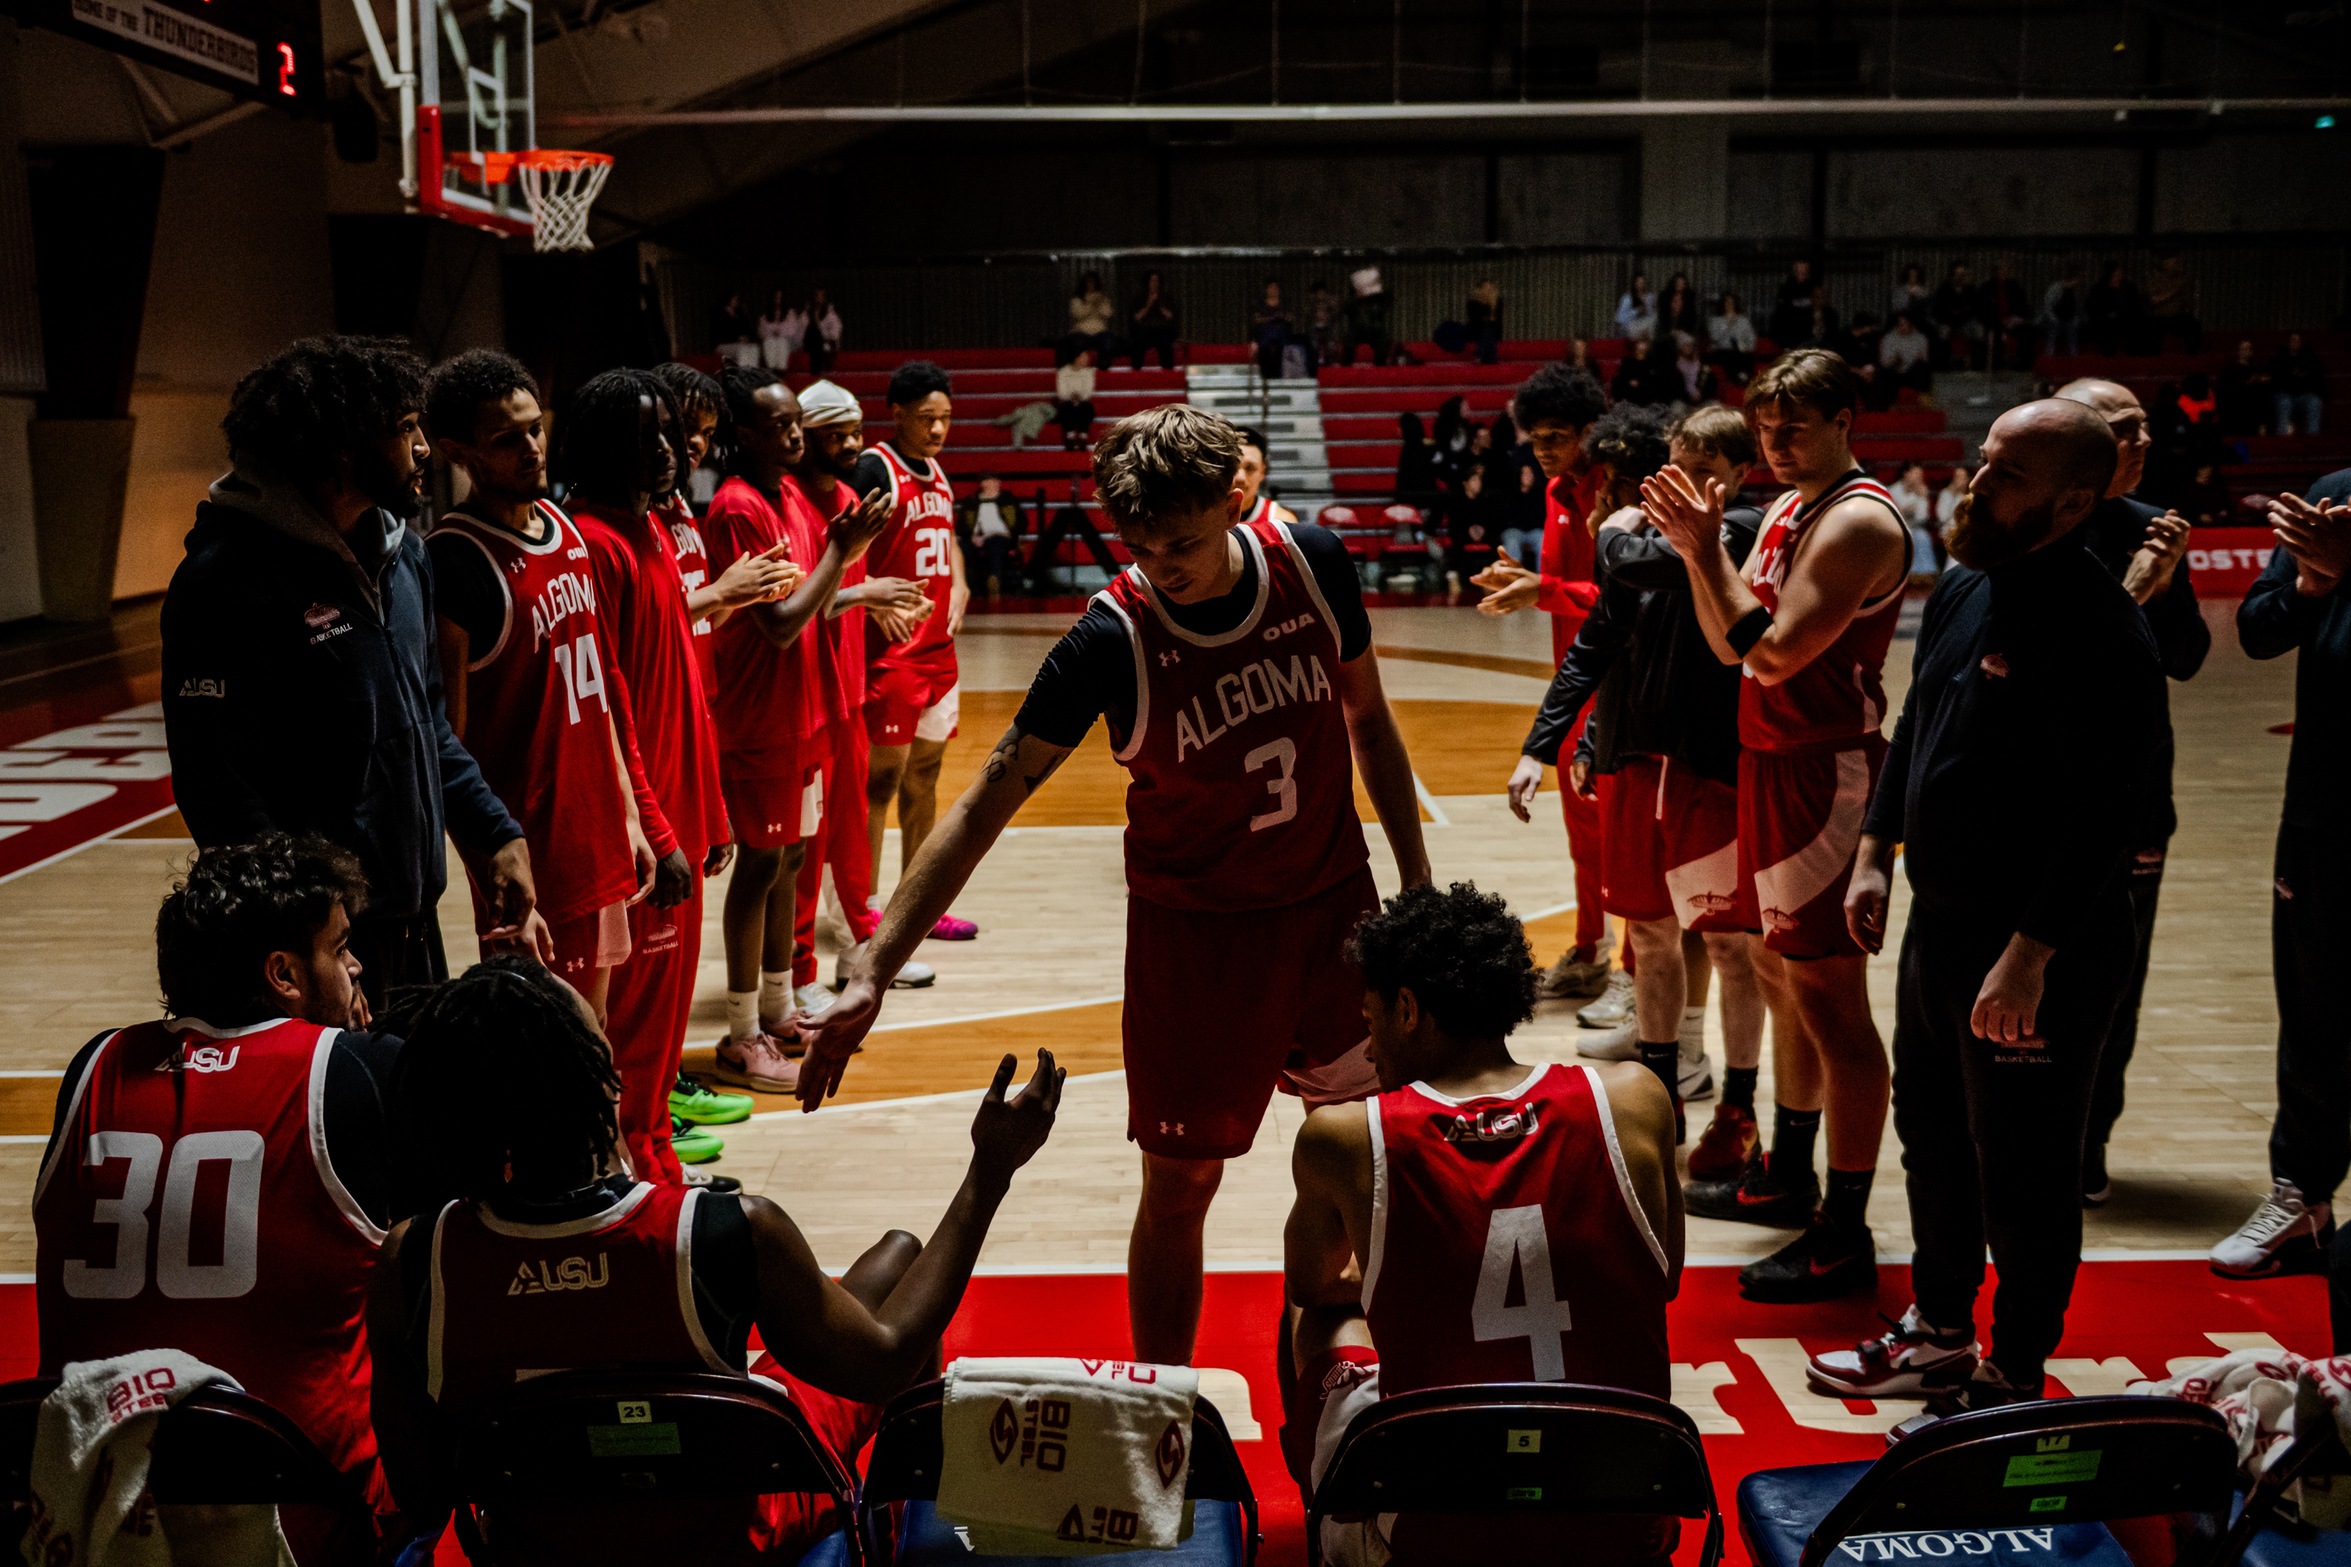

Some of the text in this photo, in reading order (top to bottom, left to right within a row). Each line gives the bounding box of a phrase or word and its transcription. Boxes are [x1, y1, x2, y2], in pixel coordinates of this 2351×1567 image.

[277, 42, 296, 96] 2
[914, 527, 951, 577] 20
[1262, 612, 1316, 643] OUA
[554, 632, 608, 726] 14
[1176, 654, 1332, 764] ALGOMA
[1244, 736, 1298, 833] 3
[62, 1130, 266, 1300] 30
[1470, 1203, 1573, 1383] 4
[107, 1367, 176, 1414] BIO
[623, 1405, 647, 1419] 23
[1019, 1399, 1040, 1467] STEEL
[1036, 1399, 1071, 1472] BIO
[1518, 1435, 1531, 1448] 5
[1838, 1527, 2054, 1563] ALGOMA
